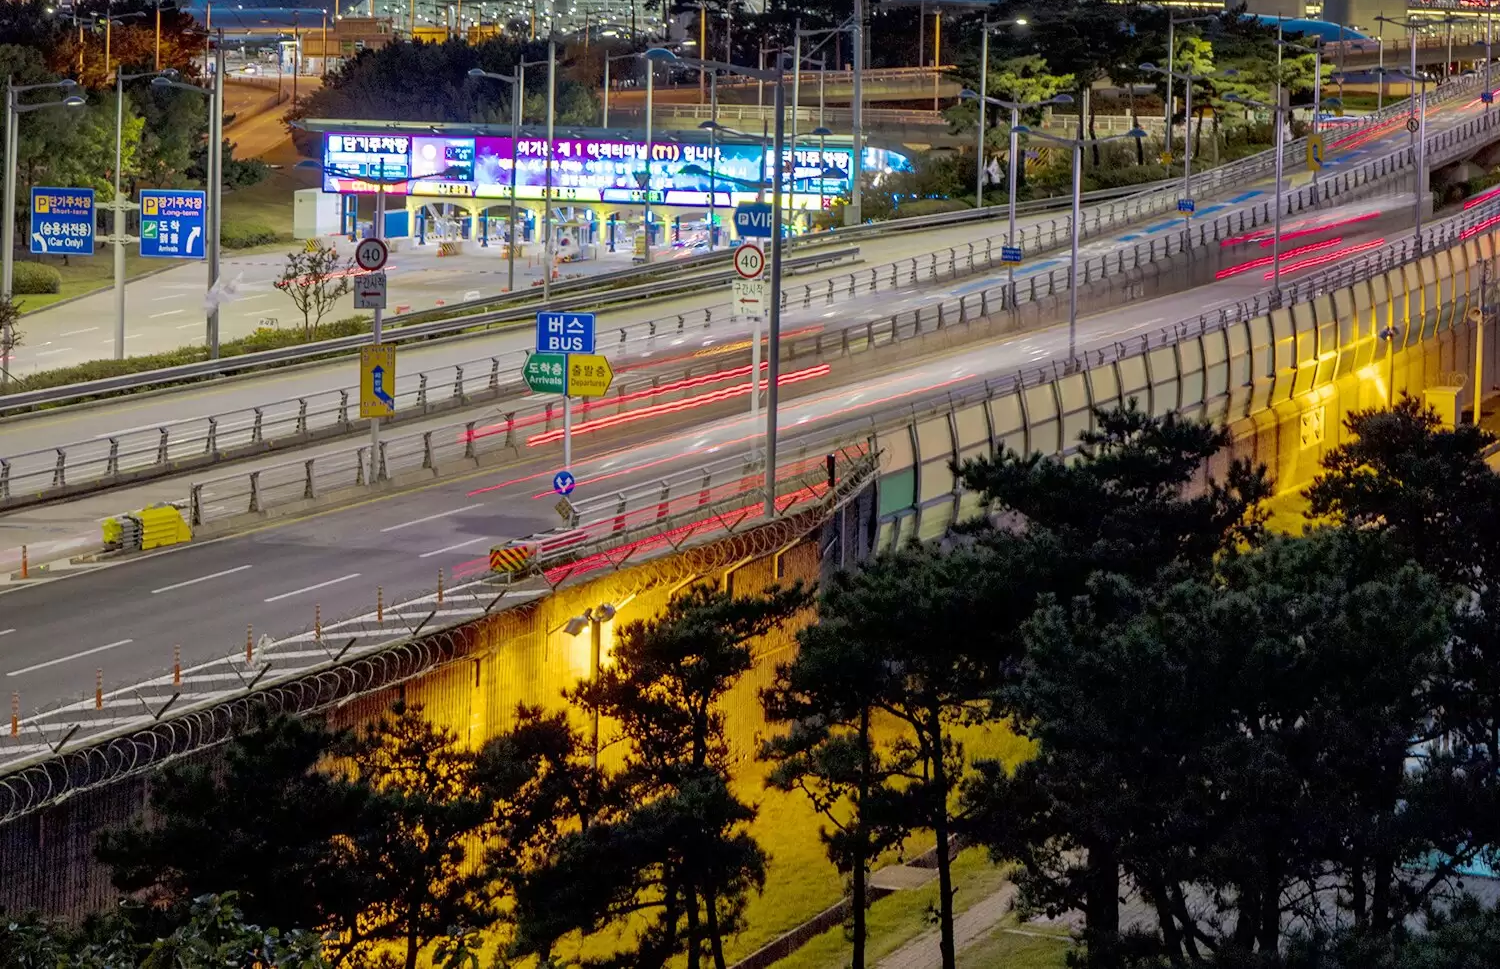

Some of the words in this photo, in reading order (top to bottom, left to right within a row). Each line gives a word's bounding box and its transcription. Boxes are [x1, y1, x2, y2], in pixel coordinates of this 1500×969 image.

[575, 143, 582, 156] 1
[652, 144, 680, 161] (T1)
[49, 196, 91, 208] 단기주차장
[158, 197, 203, 209] 장기주차장
[162, 209, 199, 217] Long-term
[40, 222, 91, 237] (승용차전용)
[159, 220, 180, 233] 도착
[48, 237, 63, 246] (Car
[65, 238, 83, 249] Only)
[158, 245, 179, 253] Arrivals
[362, 249, 380, 261] 40
[741, 255, 758, 268] 40
[733, 283, 763, 297] 구간시작
[548, 315, 584, 335] 버스
[549, 337, 583, 350] BUS
[528, 362, 562, 376] 도착층
[529, 375, 562, 385] Arrivals
[571, 378, 606, 387] Departures
